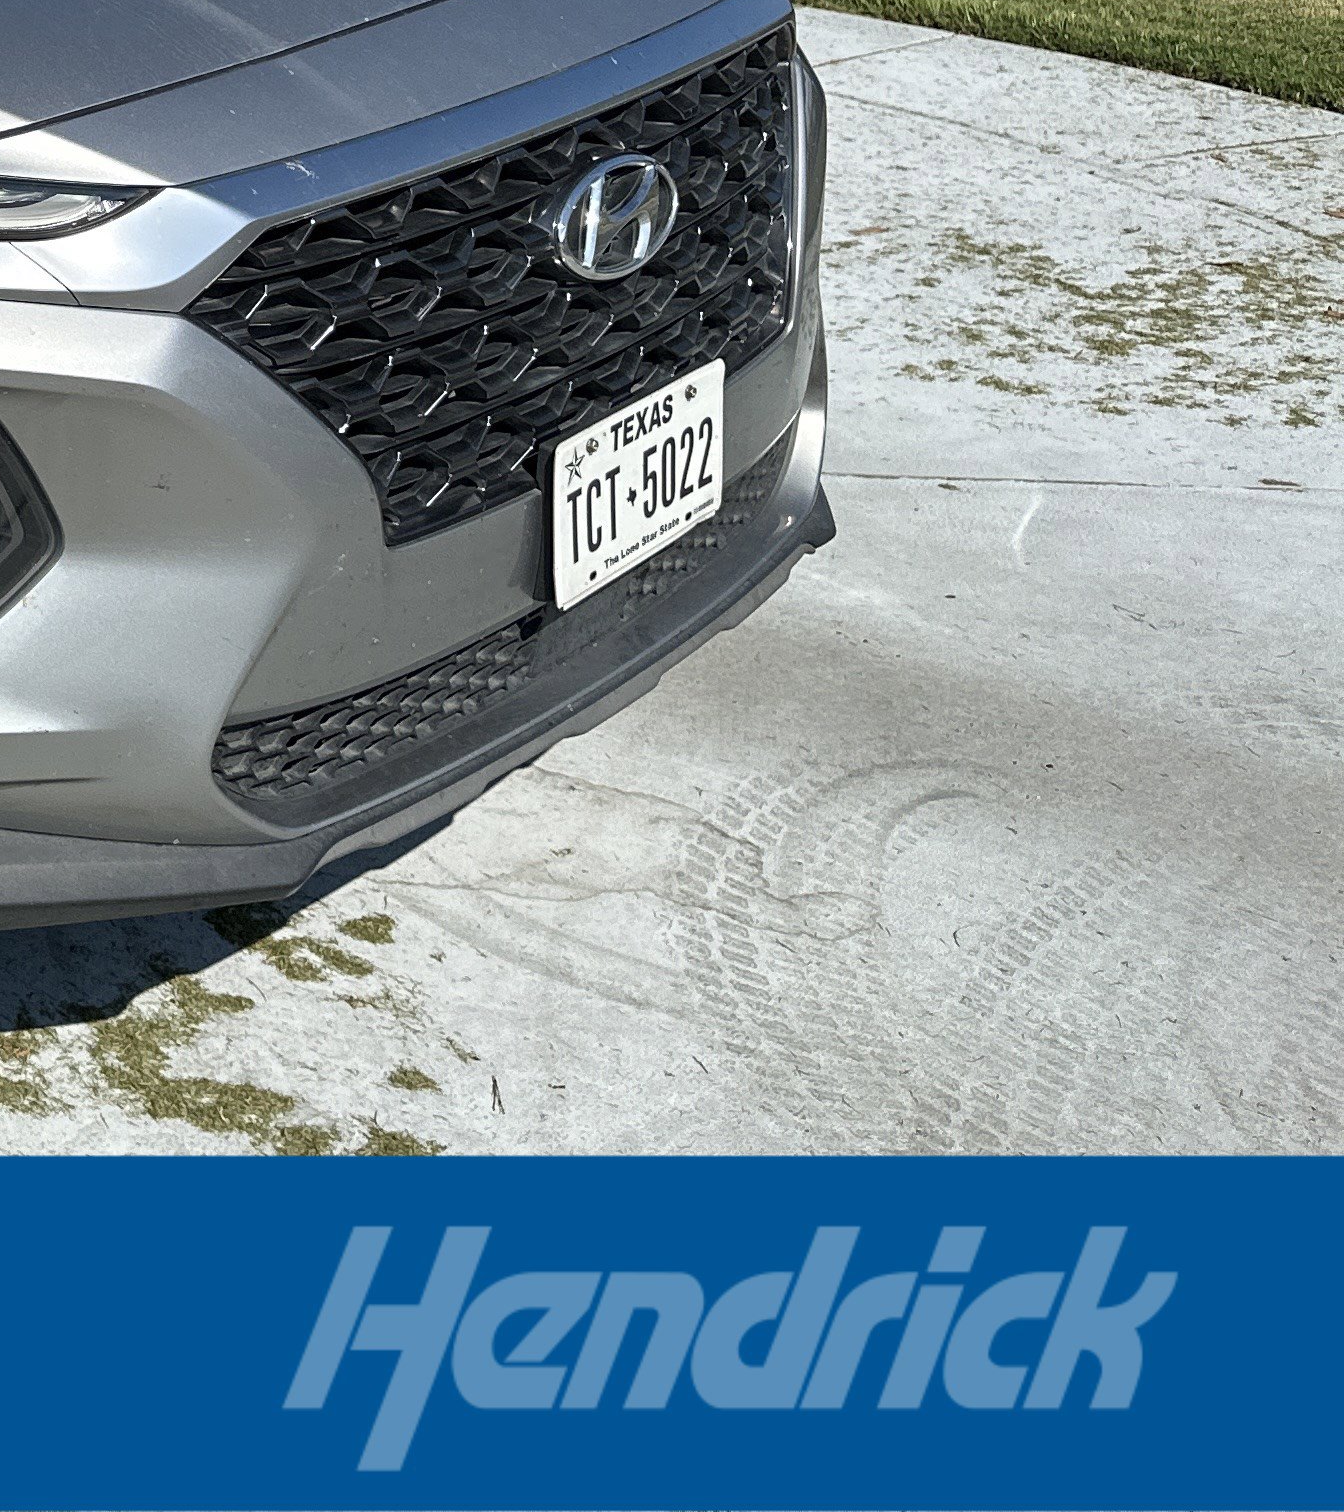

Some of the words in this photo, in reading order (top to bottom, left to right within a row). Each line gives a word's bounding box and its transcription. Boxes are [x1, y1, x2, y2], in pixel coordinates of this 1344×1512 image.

[610, 394, 674, 452] TEXAS
[604, 554, 619, 569] The
[620, 541, 640, 560] Lone
[641, 530, 658, 547] Star
[659, 517, 680, 536] State
